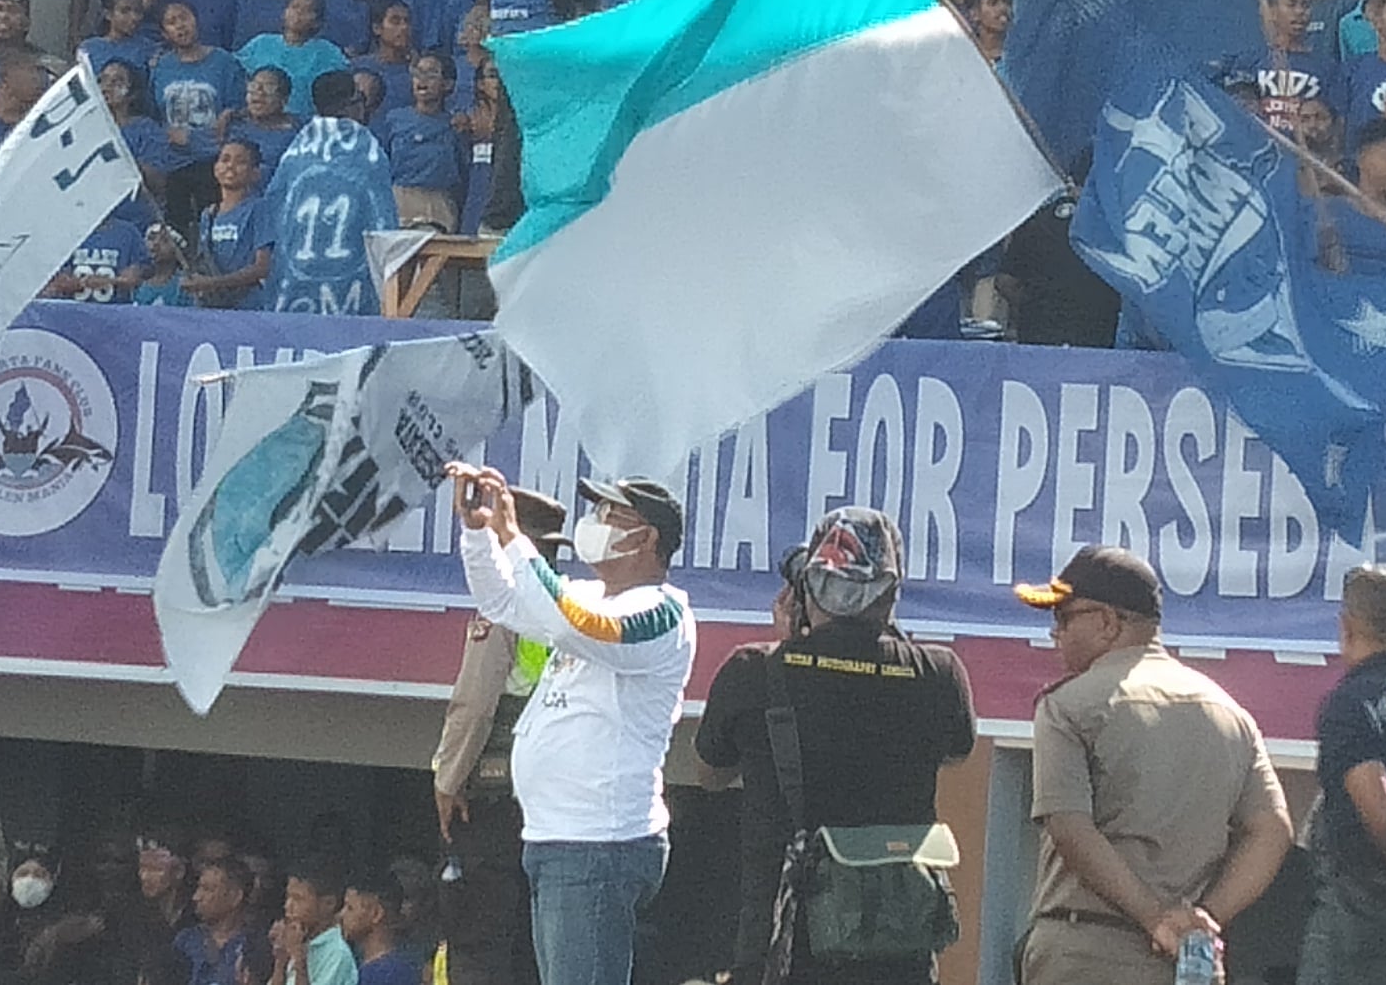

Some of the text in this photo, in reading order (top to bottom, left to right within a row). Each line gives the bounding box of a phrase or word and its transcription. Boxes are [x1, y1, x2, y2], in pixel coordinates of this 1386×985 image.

[1258, 70, 1321, 99] KIDS
[295, 192, 351, 261] 11
[807, 372, 965, 581] FOR
